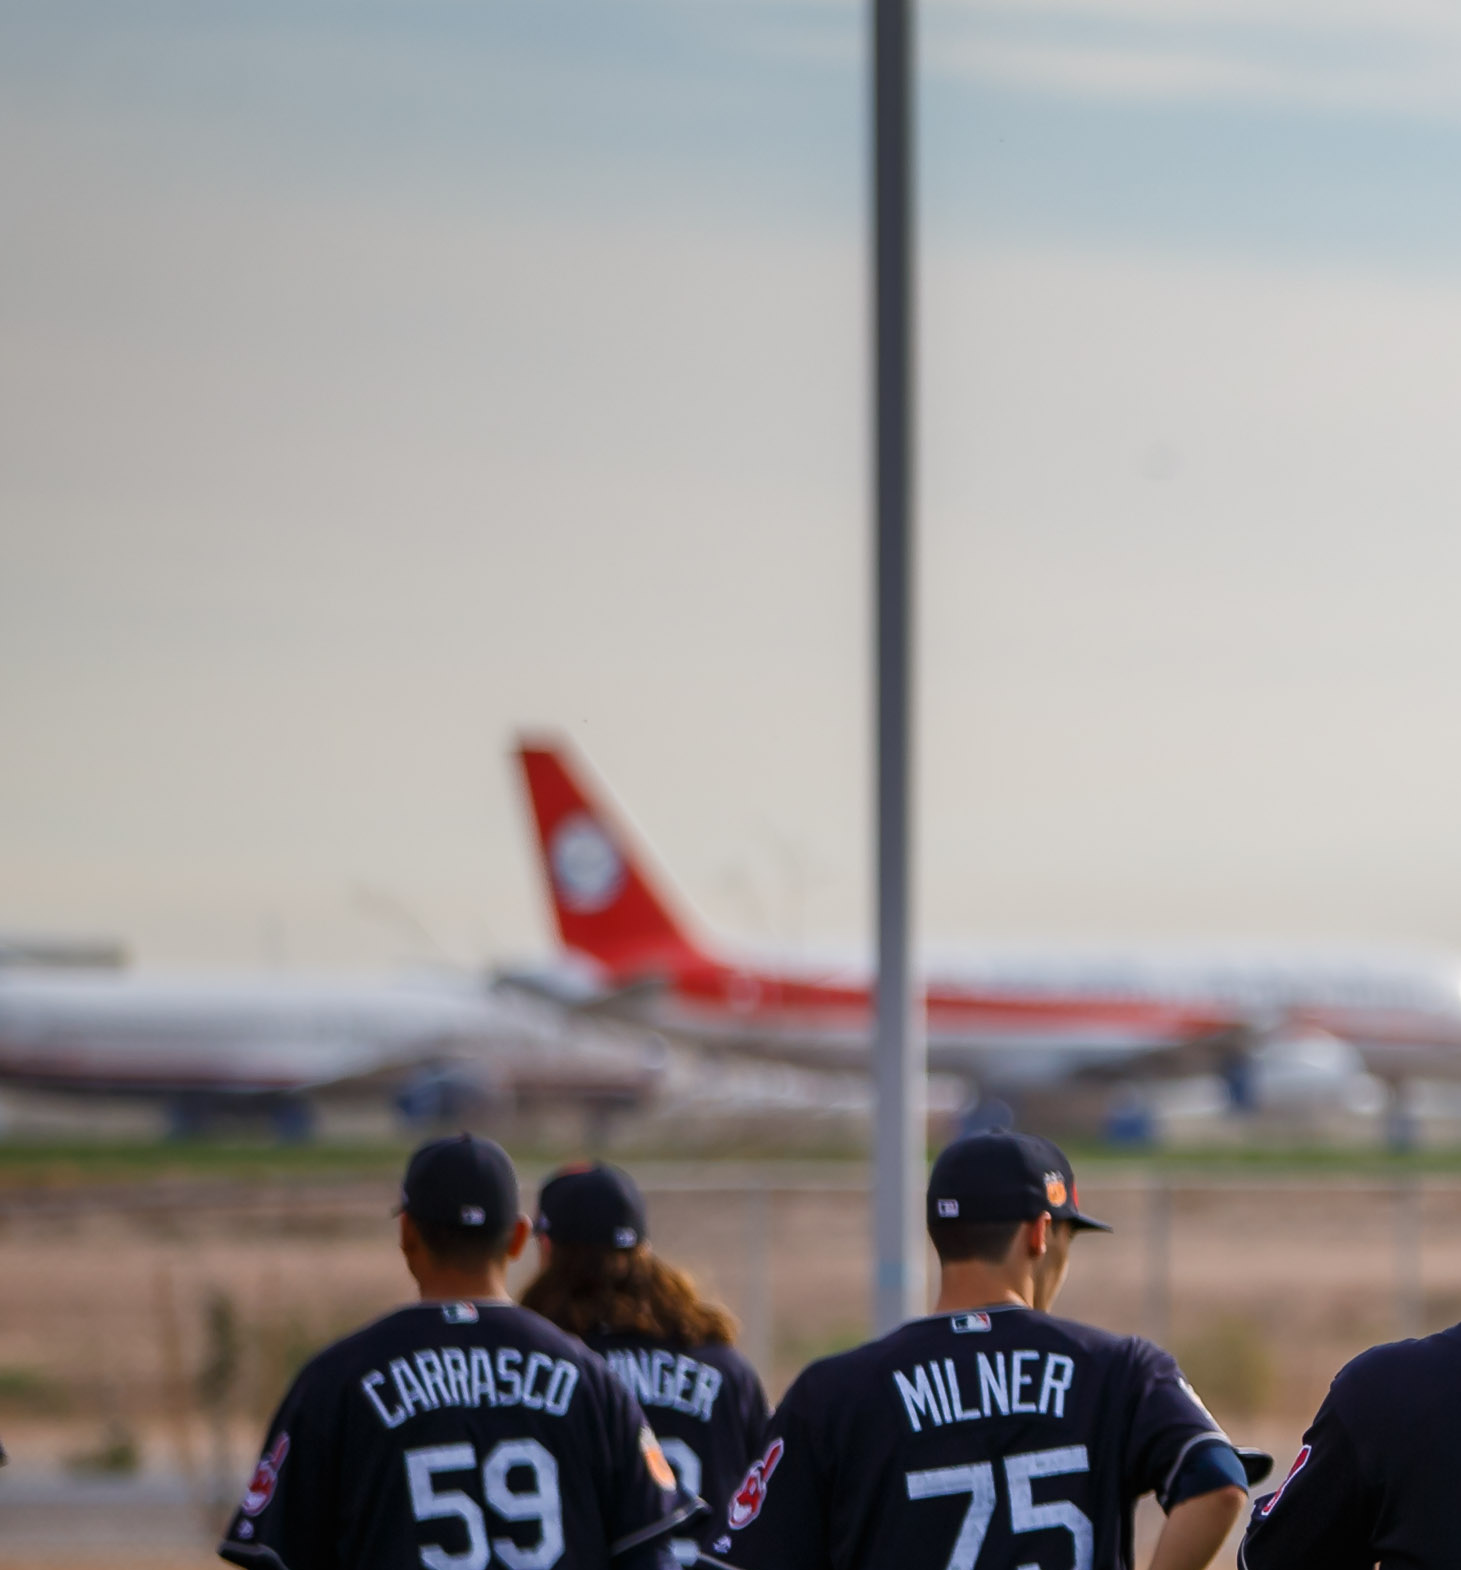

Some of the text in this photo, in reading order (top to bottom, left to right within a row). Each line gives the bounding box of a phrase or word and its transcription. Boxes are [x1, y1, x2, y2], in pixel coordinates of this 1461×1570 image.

[361, 1346, 581, 1430] CARRASCO
[608, 1348, 723, 1421] INGER
[893, 1350, 1075, 1433] MILNER
